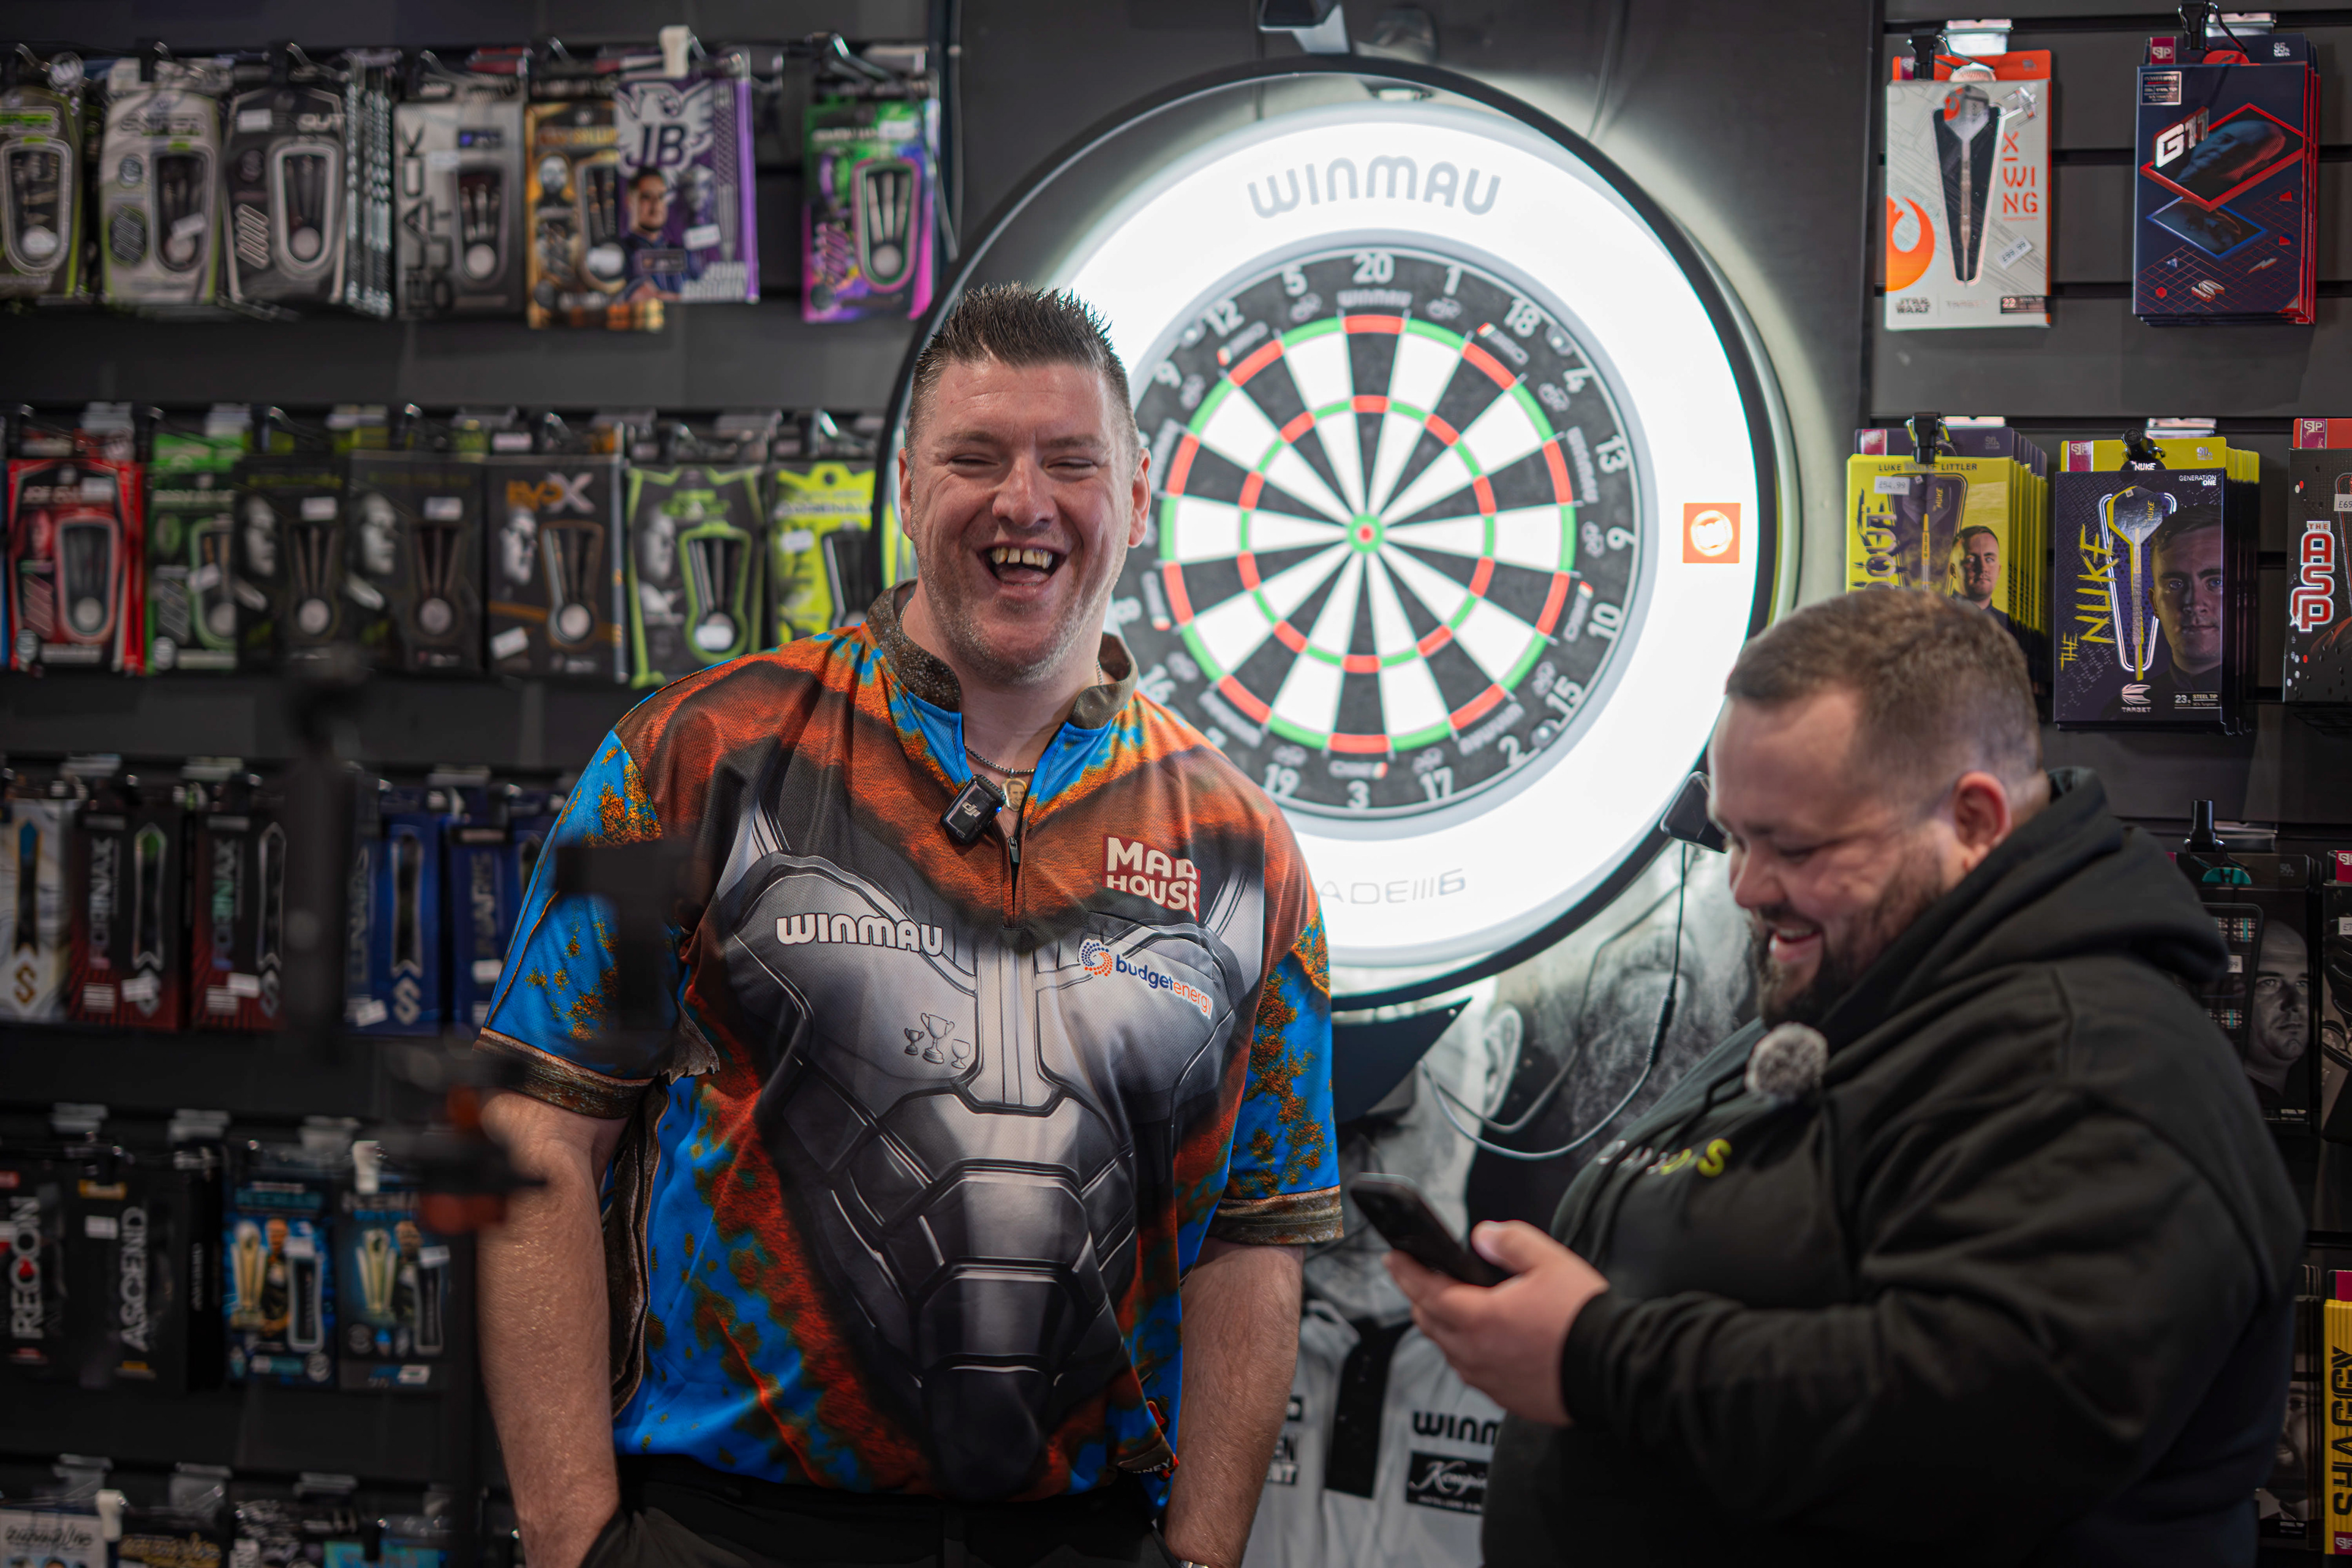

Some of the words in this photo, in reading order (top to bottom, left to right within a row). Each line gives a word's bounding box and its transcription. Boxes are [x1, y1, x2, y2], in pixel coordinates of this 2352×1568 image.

[1247, 156, 1501, 218] WINMAU
[1282, 263, 1308, 296] 5
[1352, 252, 1395, 284] 20
[1444, 265, 1463, 296] 1
[1204, 299, 1245, 337] 12
[1504, 296, 1541, 337] 18
[1564, 367, 1593, 393] 4
[2304, 420, 2325, 432] SP
[1596, 435, 1629, 473] 13
[2135, 462, 2157, 471] NUKE
[2058, 631, 2079, 671] THE
[2075, 522, 2120, 644] NUKE
[2290, 530, 2335, 632] ASP
[1588, 602, 1622, 639] 10
[1545, 676, 1583, 714] 15
[1498, 735, 1526, 767] 2
[1264, 763, 1300, 797] 19
[1348, 780, 1370, 809] 3
[1419, 767, 1452, 801] 17
[1107, 837, 1197, 880] MAD
[1107, 875, 1197, 918] HOUSE
[775, 912, 944, 957] WINMAU
[120, 1207, 148, 1351] ASCEND
